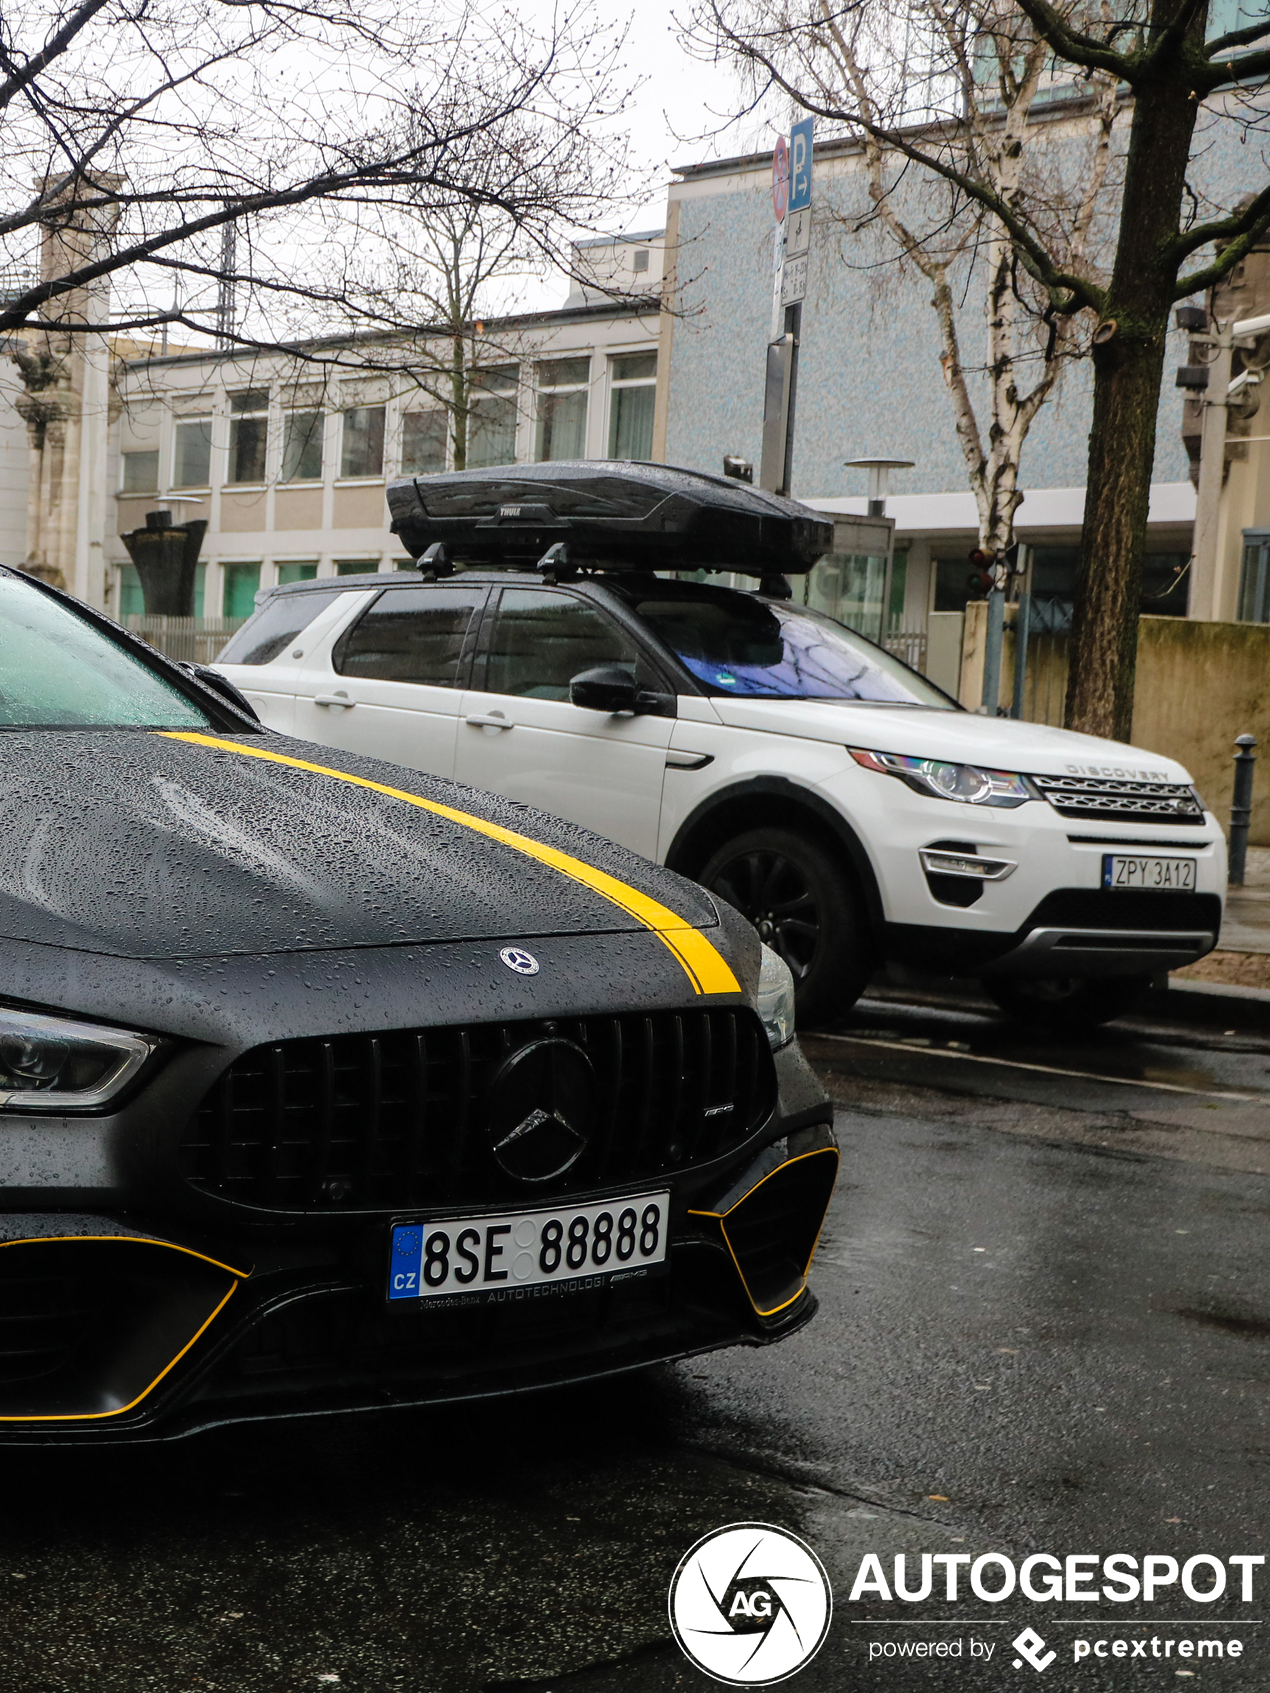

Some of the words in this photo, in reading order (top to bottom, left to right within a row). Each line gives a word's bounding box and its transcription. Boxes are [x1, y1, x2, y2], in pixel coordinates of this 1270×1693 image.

[792, 133, 806, 200] P
[500, 507, 521, 516] THULE
[1065, 764, 1169, 782] DISCOVERY
[1116, 859, 1148, 885] ZPY
[1154, 861, 1191, 887] 3A12
[423, 1224, 512, 1287] 8SE
[539, 1202, 661, 1274] 88888
[394, 1272, 416, 1290] CZ
[420, 1295, 481, 1310] Mercedes-Benz
[487, 1276, 605, 1303] AUTOTECHNOLOGI
